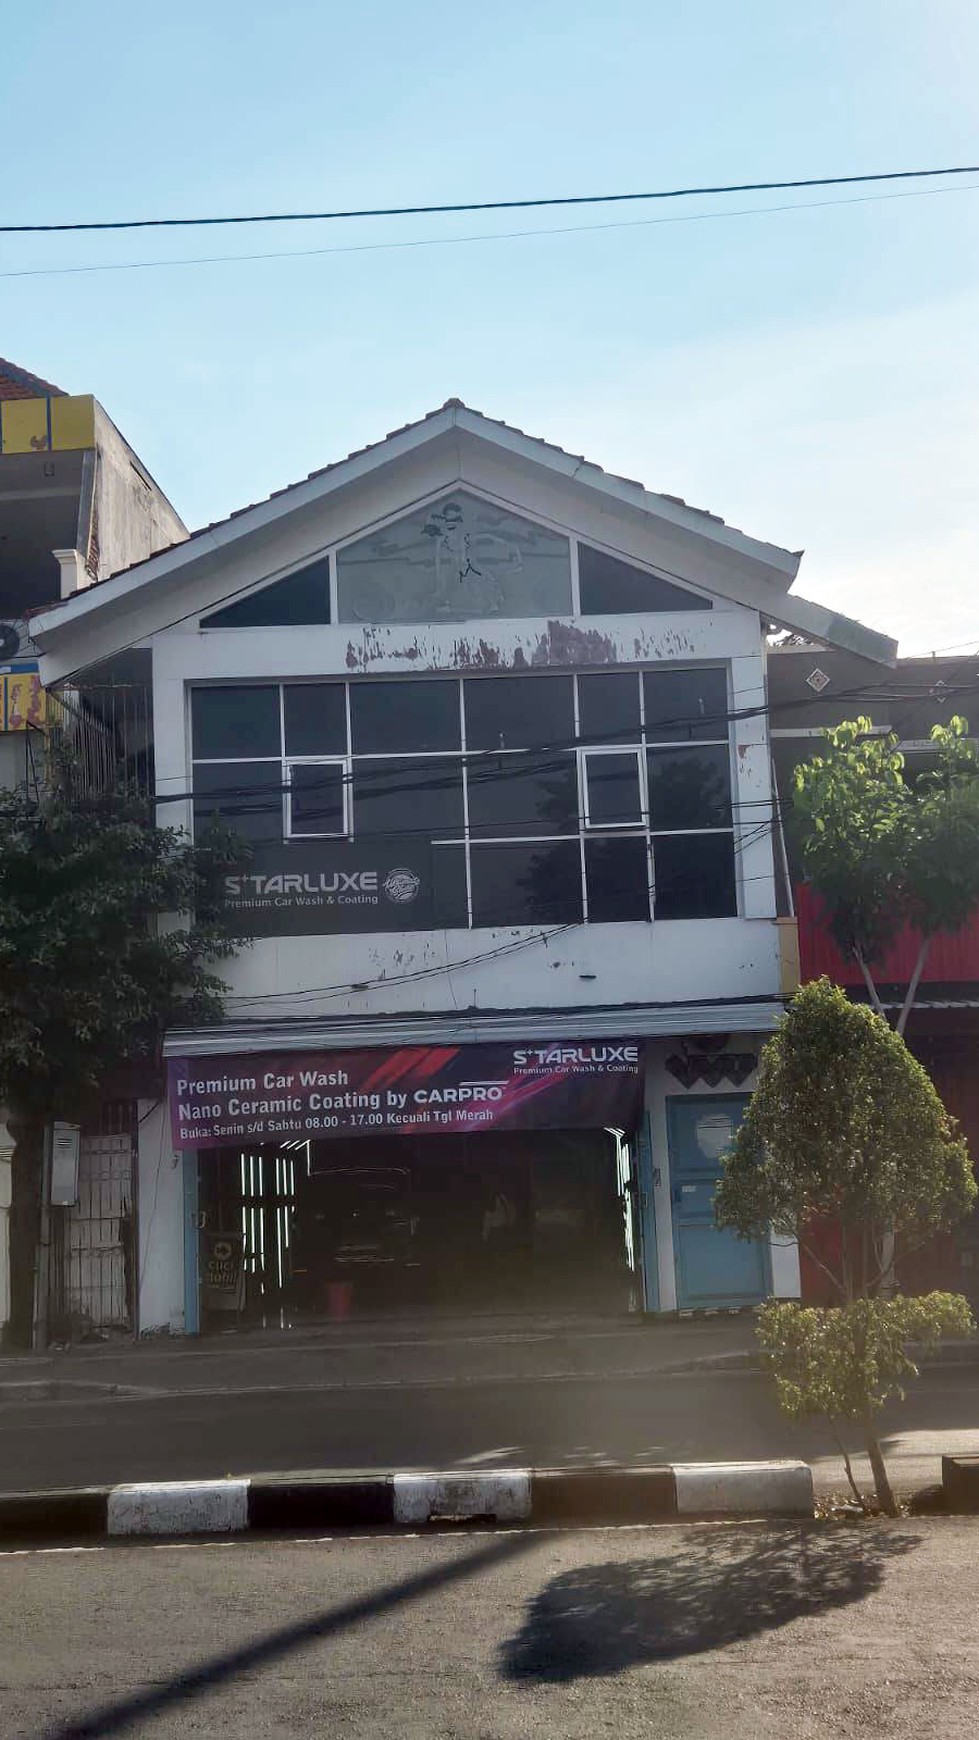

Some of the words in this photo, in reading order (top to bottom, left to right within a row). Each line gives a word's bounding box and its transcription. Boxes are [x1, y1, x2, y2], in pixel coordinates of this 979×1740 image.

[224, 898, 272, 908] Premium
[274, 897, 292, 906] Car
[295, 895, 323, 906] Wash
[326, 895, 335, 904] &
[337, 894, 378, 906] Coating
[177, 1074, 256, 1096] Premium
[263, 1072, 295, 1090] Car
[300, 1069, 348, 1088] Wash
[513, 1066, 551, 1075] Premium
[555, 1065, 569, 1073] Car
[573, 1064, 595, 1073] Wash
[606, 1064, 639, 1074] Coating
[178, 1102, 221, 1121] Nano
[228, 1096, 301, 1116] Ceramic
[309, 1090, 381, 1110] Coating
[387, 1090, 407, 1108] by
[413, 1086, 503, 1104] CARPRO
[180, 1128, 212, 1139] Buka:
[213, 1124, 244, 1136] Senin
[247, 1121, 264, 1133] s/d
[268, 1119, 301, 1132] Sabtu
[305, 1116, 339, 1129] 08.00
[350, 1113, 383, 1126] 17.00
[387, 1111, 430, 1124] Kecuali
[432, 1110, 452, 1123] Tgl
[456, 1109, 494, 1121] Merah
